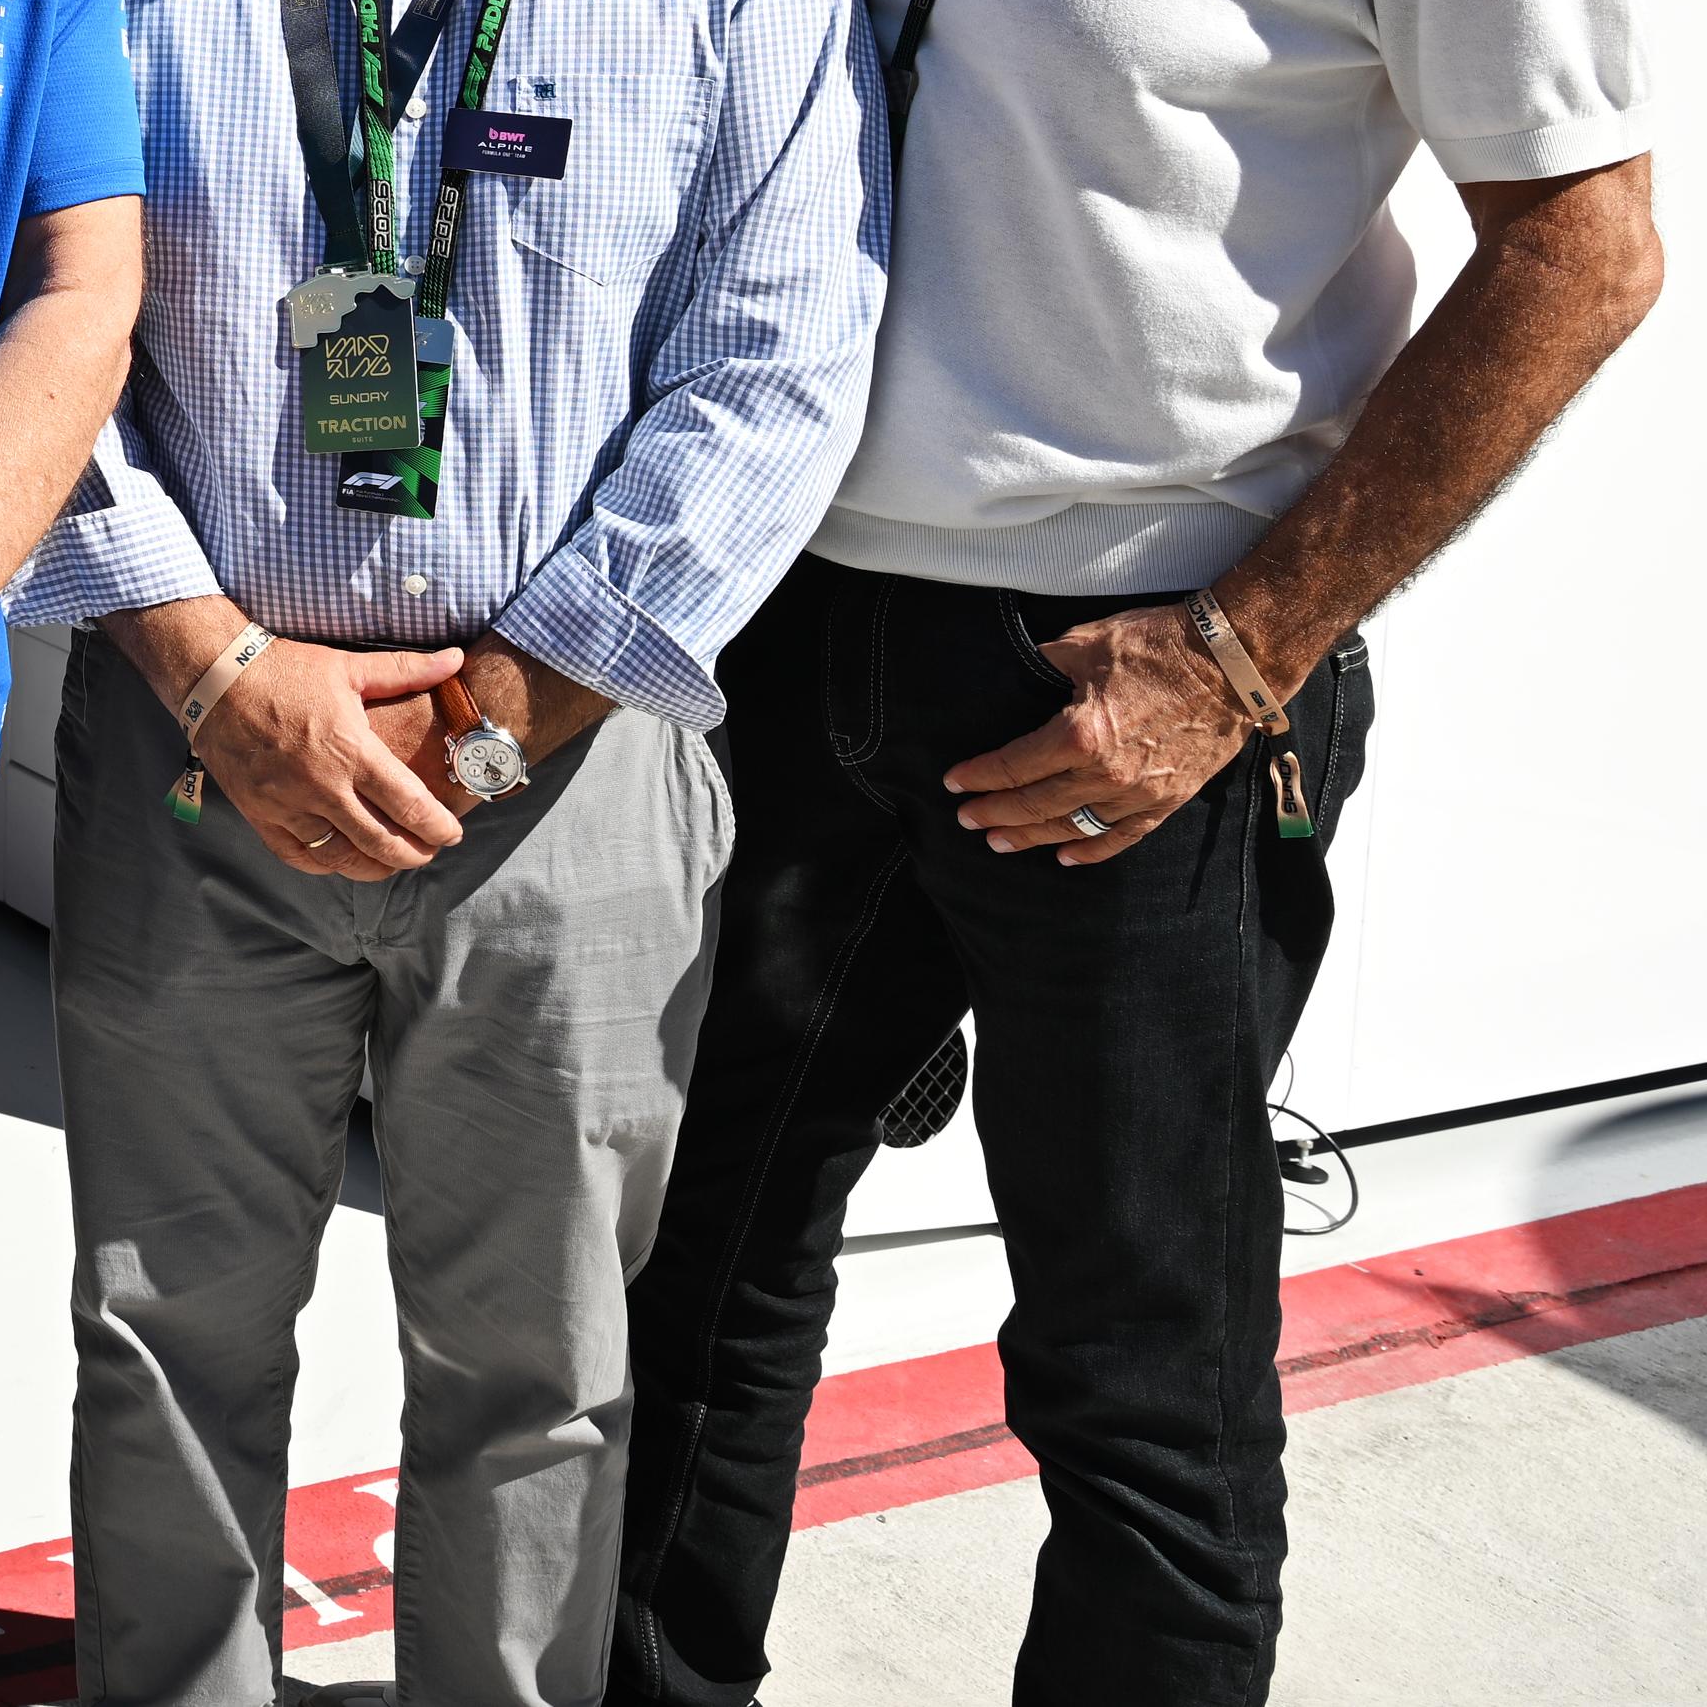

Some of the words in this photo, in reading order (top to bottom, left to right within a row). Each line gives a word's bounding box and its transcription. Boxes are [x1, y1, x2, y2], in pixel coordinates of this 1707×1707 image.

[499, 132, 526, 142] BWT
[477, 141, 533, 153] ALPINE
[329, 391, 390, 406] SUNDAY
[317, 415, 408, 434] TRACTION
[352, 435, 374, 444] SUITE
